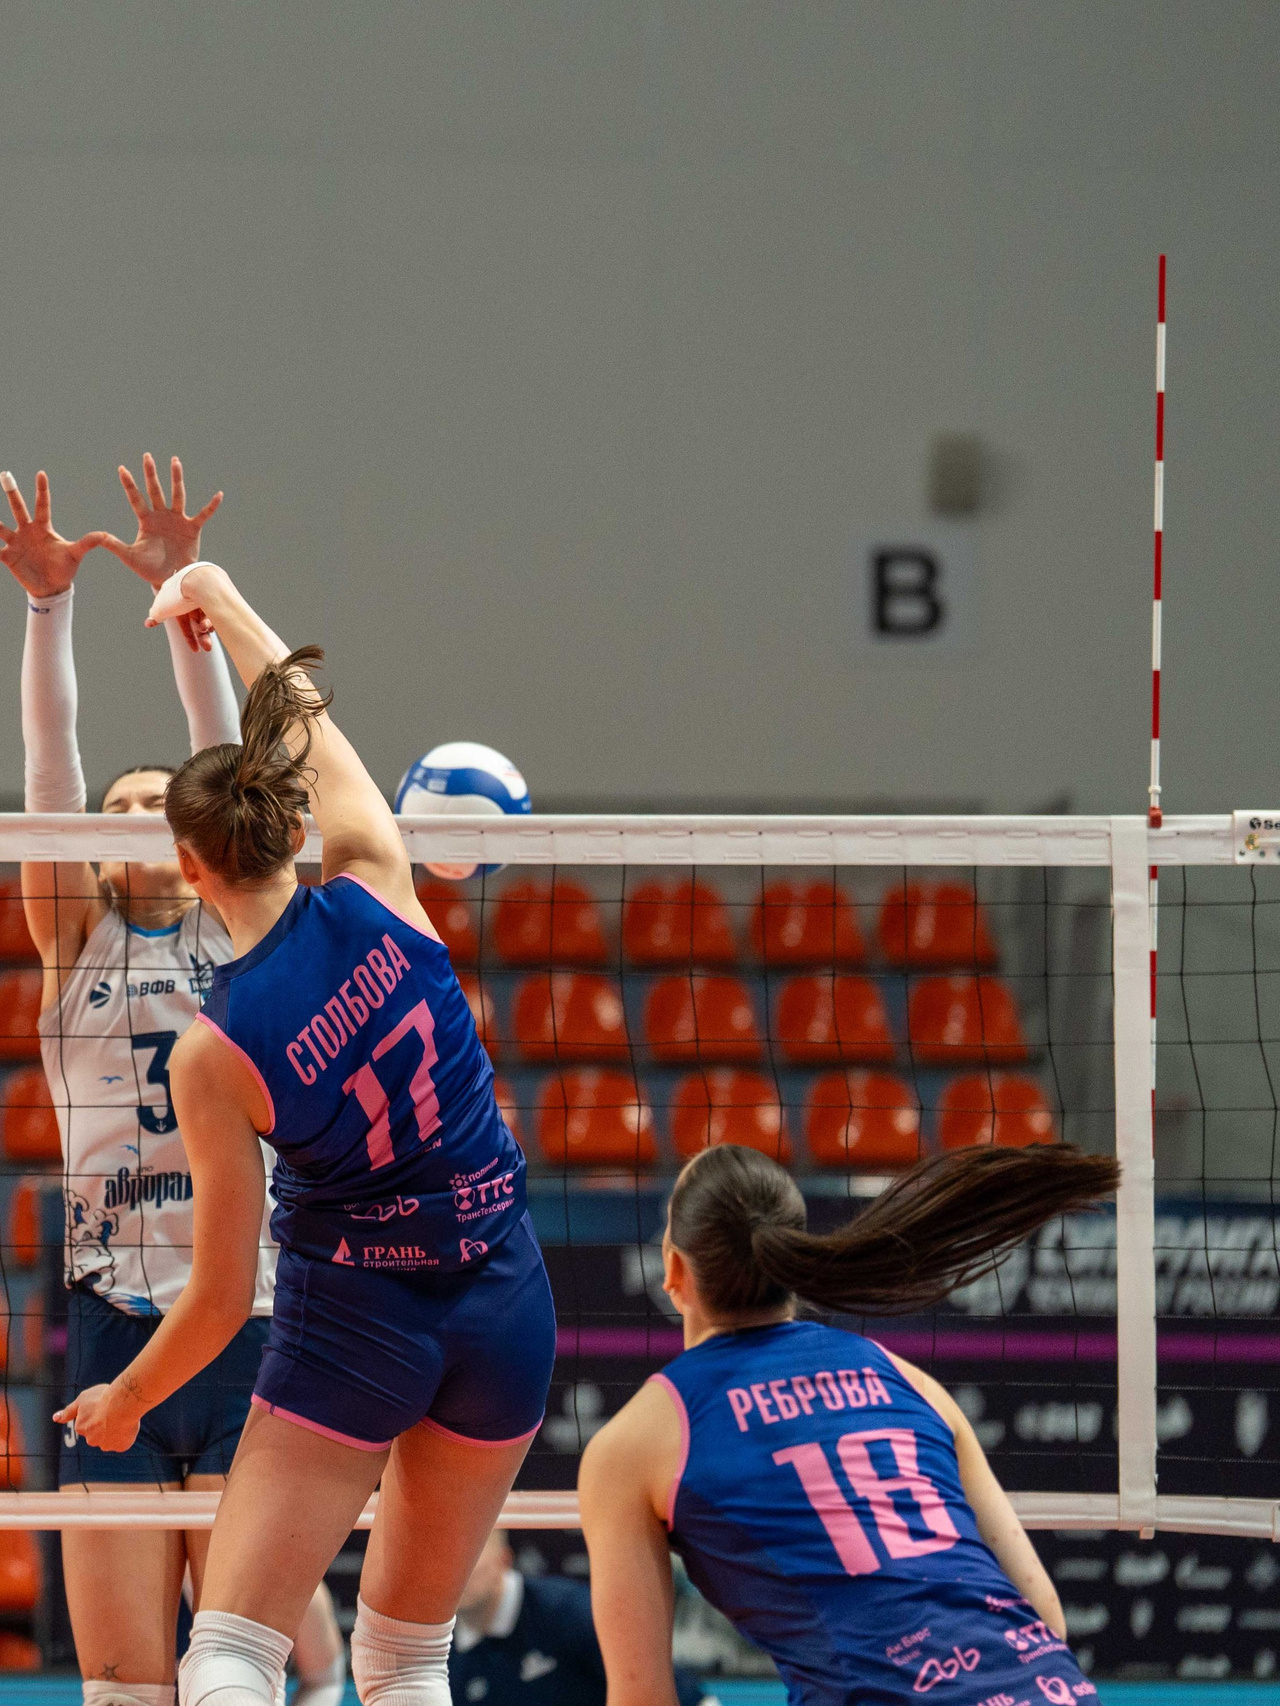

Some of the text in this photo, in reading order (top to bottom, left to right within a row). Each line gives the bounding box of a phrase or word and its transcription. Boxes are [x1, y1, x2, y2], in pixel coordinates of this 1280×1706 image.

[140, 980, 176, 996] ВФВ
[286, 933, 411, 1086] СТОЛБОВА
[131, 1031, 179, 1135] 3
[341, 998, 443, 1171] 17
[456, 1198, 515, 1223] ТрансТехСерви
[477, 1173, 514, 1204] ТТС
[363, 1246, 427, 1259] ГРАНЬ
[363, 1259, 440, 1268] строительная
[726, 1366, 893, 1434] РЕБРОВА
[772, 1428, 962, 1576] 18
